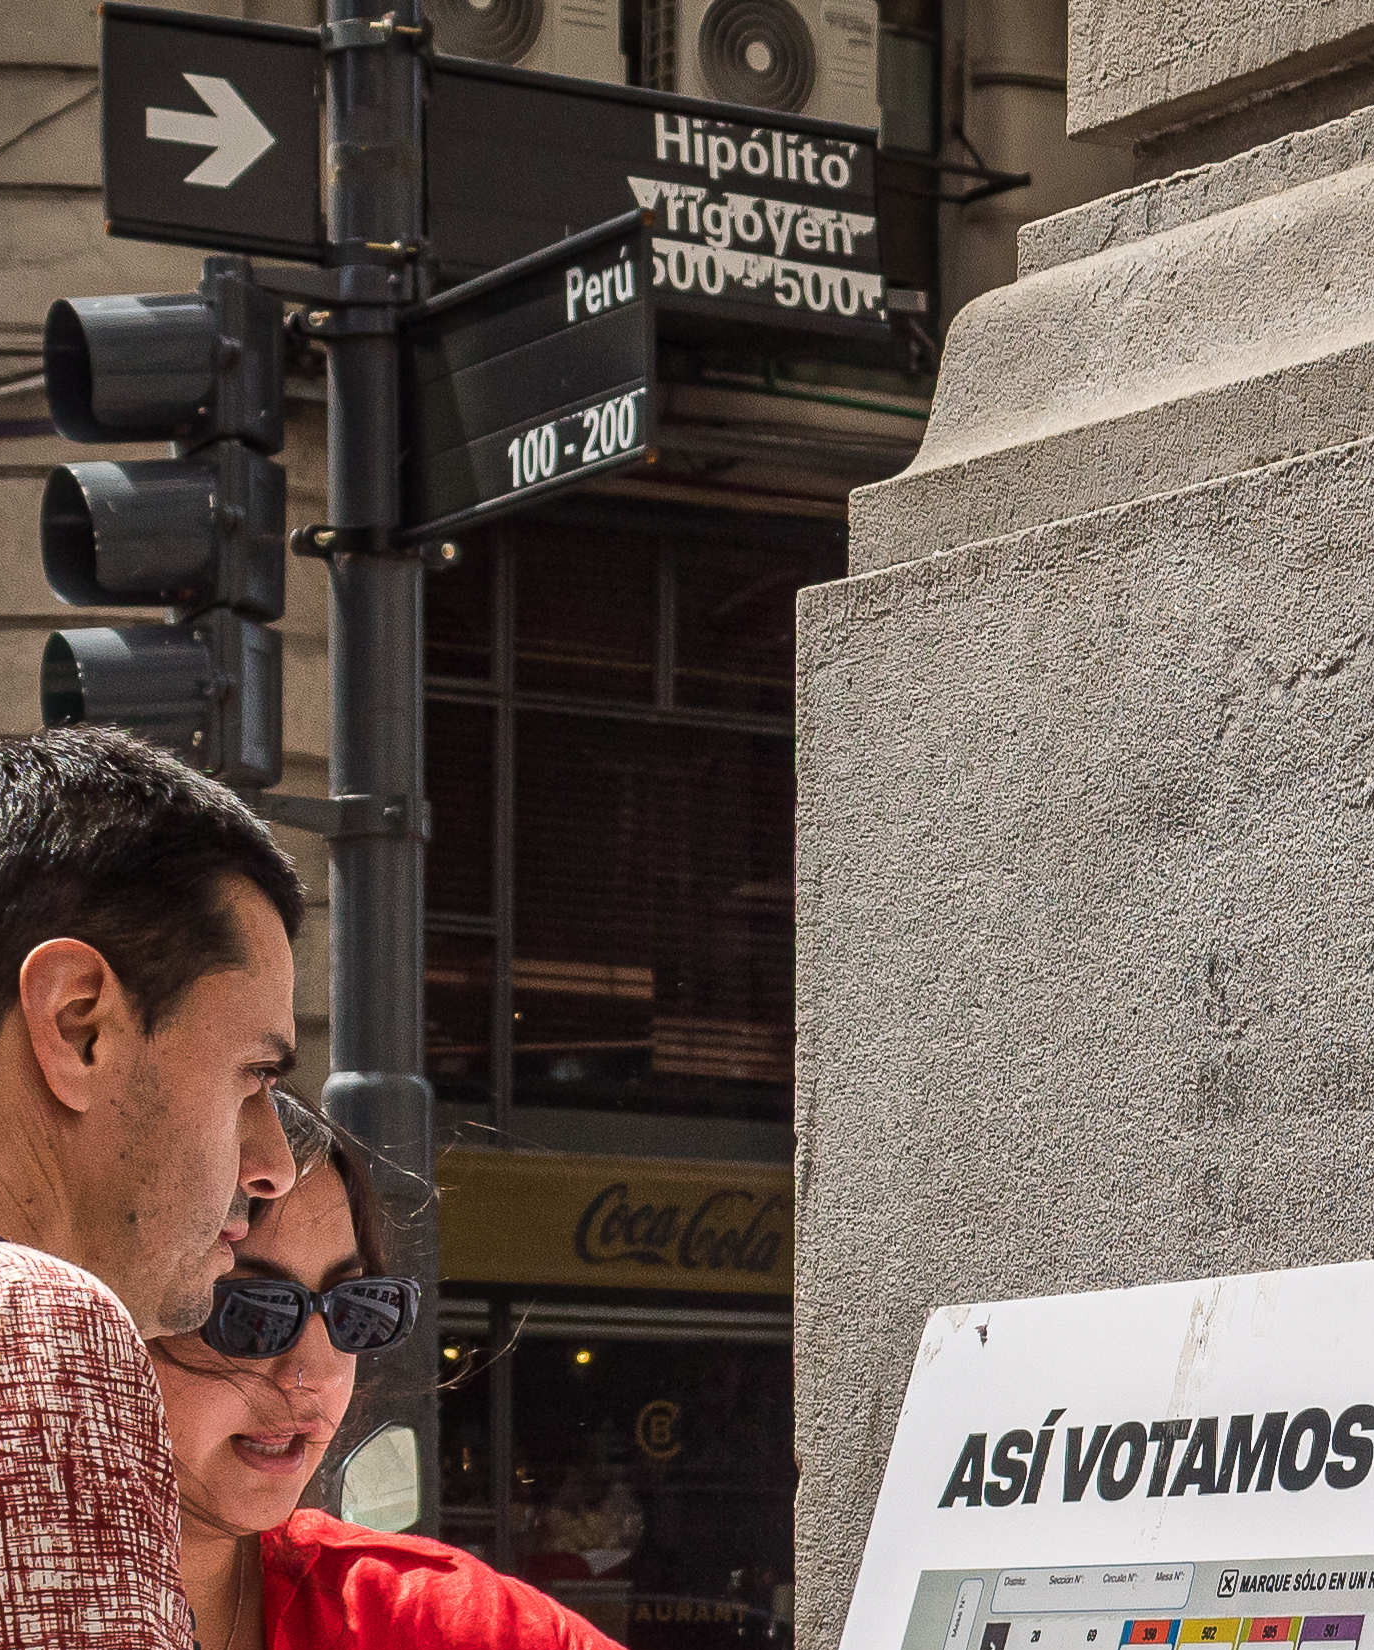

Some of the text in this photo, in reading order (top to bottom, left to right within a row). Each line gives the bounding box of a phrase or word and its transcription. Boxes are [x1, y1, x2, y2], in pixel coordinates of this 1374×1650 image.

[654, 112, 851, 188] Hipólito
[565, 246, 636, 322] Perú
[508, 421, 558, 487] 100
[582, 395, 637, 462] 200
[937, 1408, 1067, 1509] ASÍ
[1239, 1573, 1292, 1593] MARQUE
[1293, 1568, 1326, 1591] SÓLO
[1328, 1571, 1347, 1590] EN
[1348, 1570, 1367, 1589] UN
